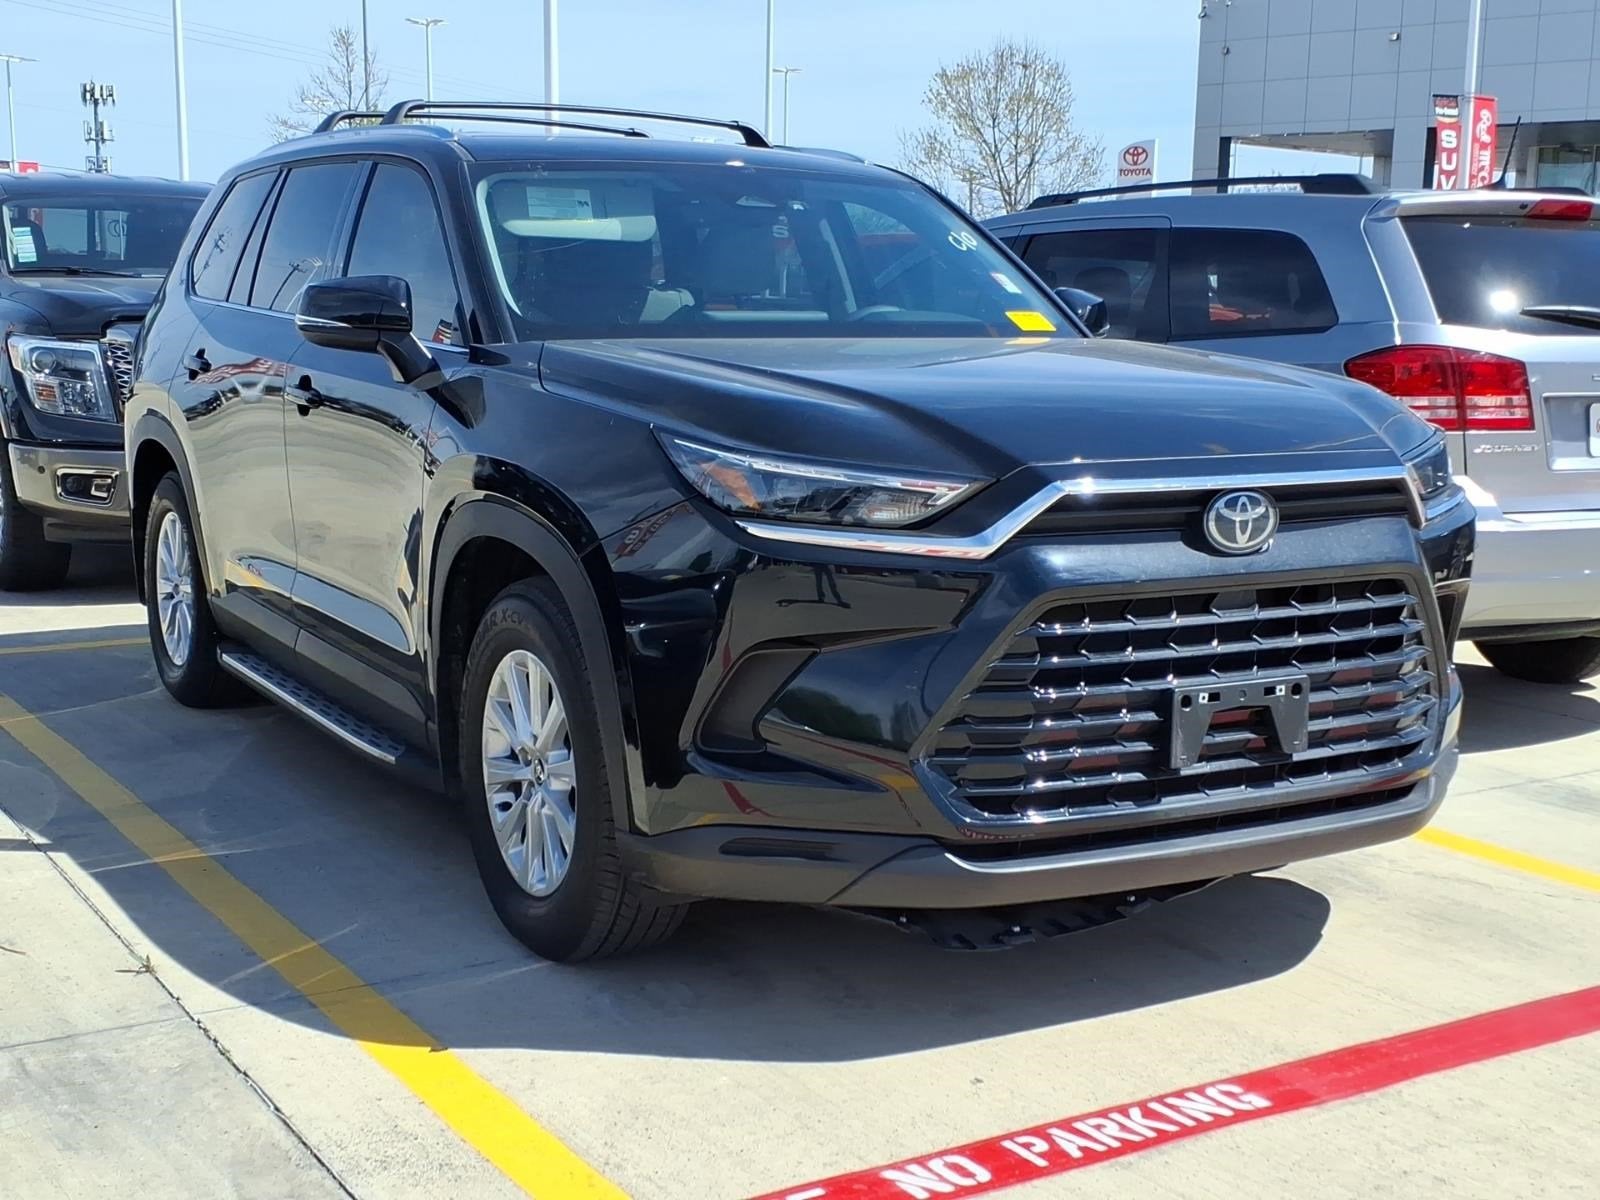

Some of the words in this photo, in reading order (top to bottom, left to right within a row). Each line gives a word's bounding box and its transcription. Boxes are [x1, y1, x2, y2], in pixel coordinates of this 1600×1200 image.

[1119, 168, 1152, 177] TOYOTA
[1477, 145, 1491, 188] McC
[880, 1154, 994, 1199] NO
[1001, 1084, 1272, 1168] PARKING
